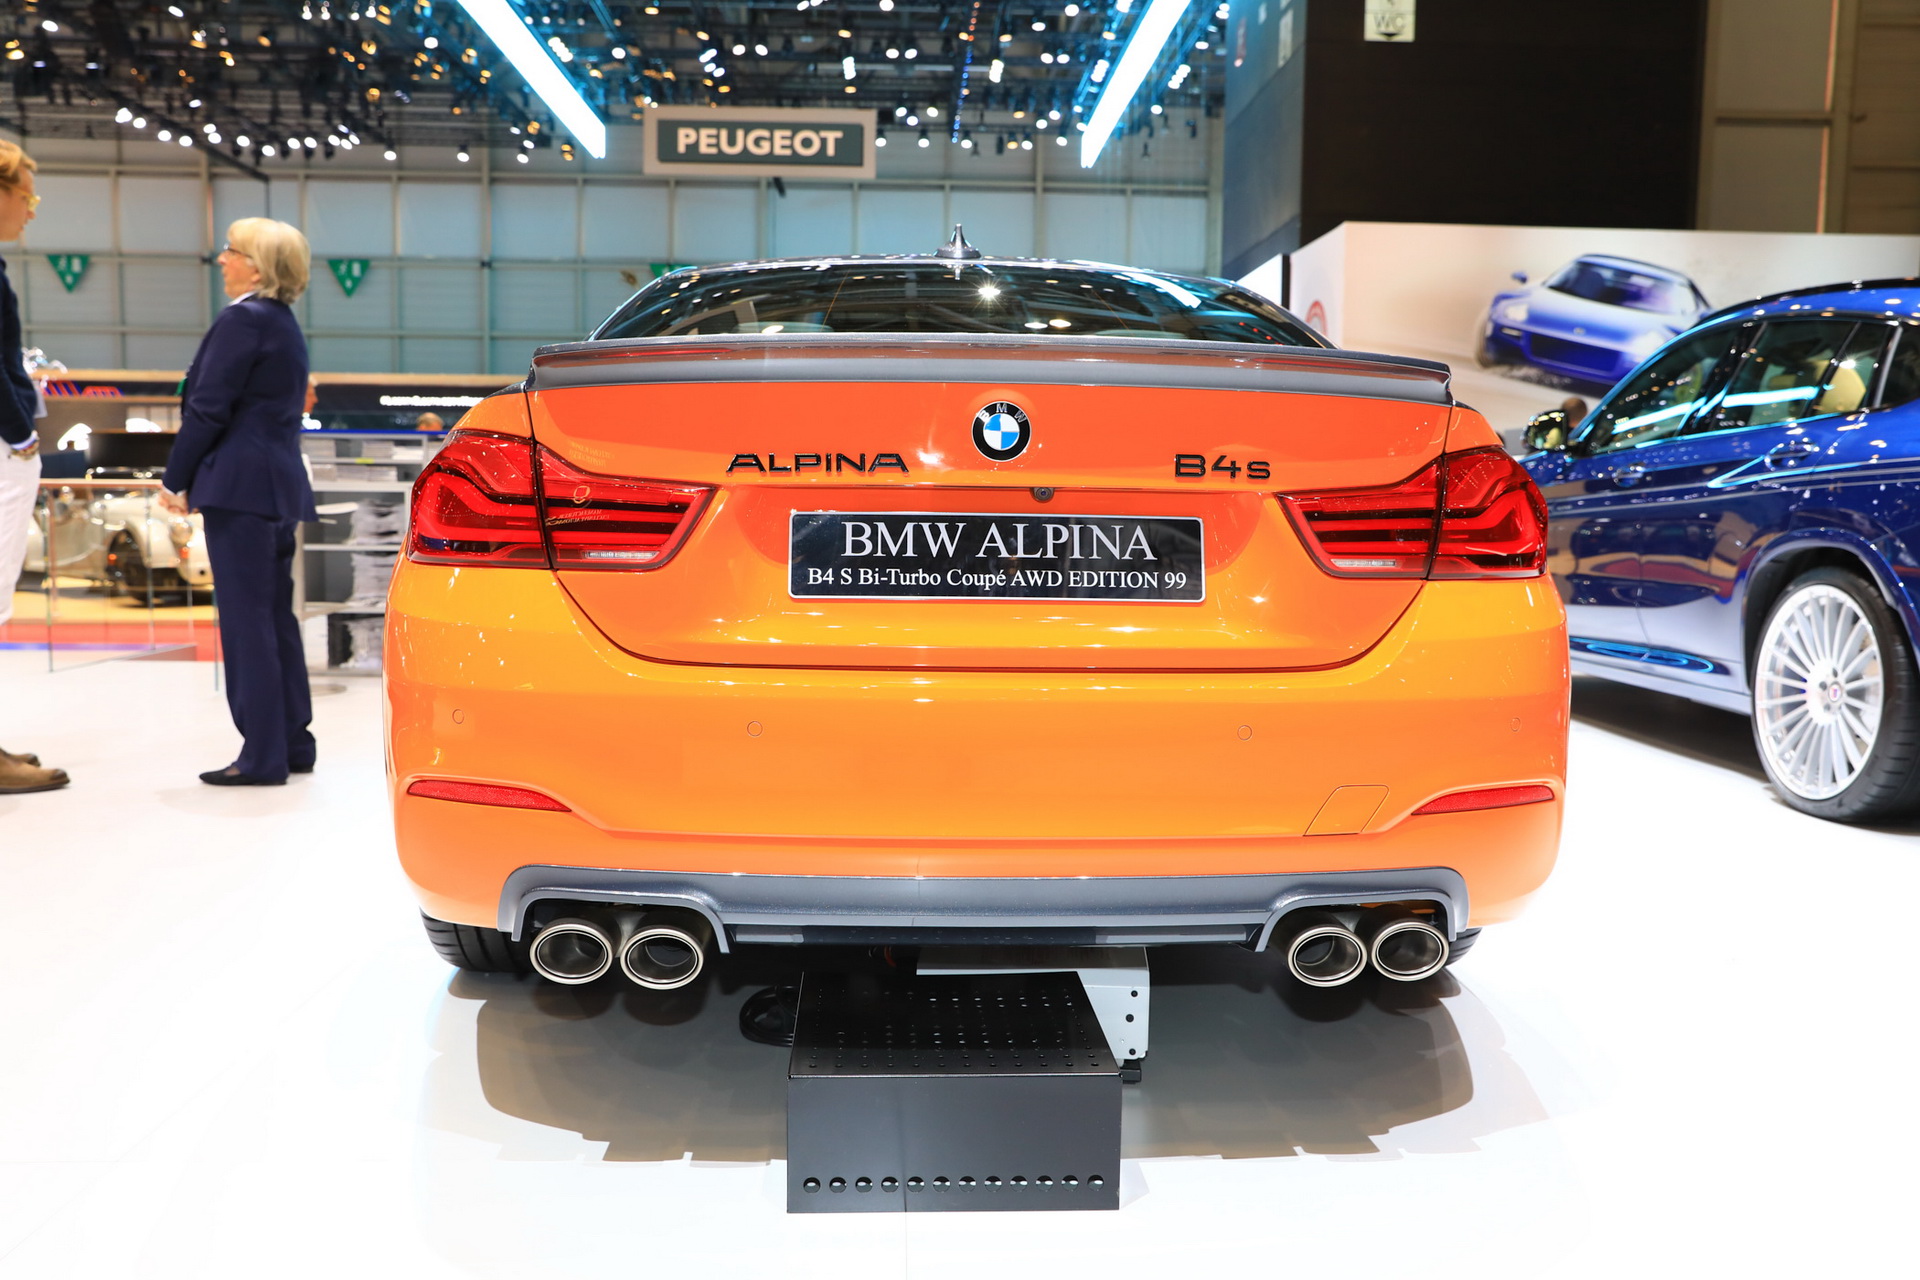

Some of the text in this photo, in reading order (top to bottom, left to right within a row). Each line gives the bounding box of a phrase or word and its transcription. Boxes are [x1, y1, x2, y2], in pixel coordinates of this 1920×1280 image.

[677, 127, 844, 157] PEUGEOT
[977, 402, 1027, 423] BMW
[726, 453, 909, 473] ALPINA
[841, 521, 1158, 561] BMW ALPINA
[807, 567, 1187, 590] B4 S Bi-Turbo Coupé AWD EDITION 99
